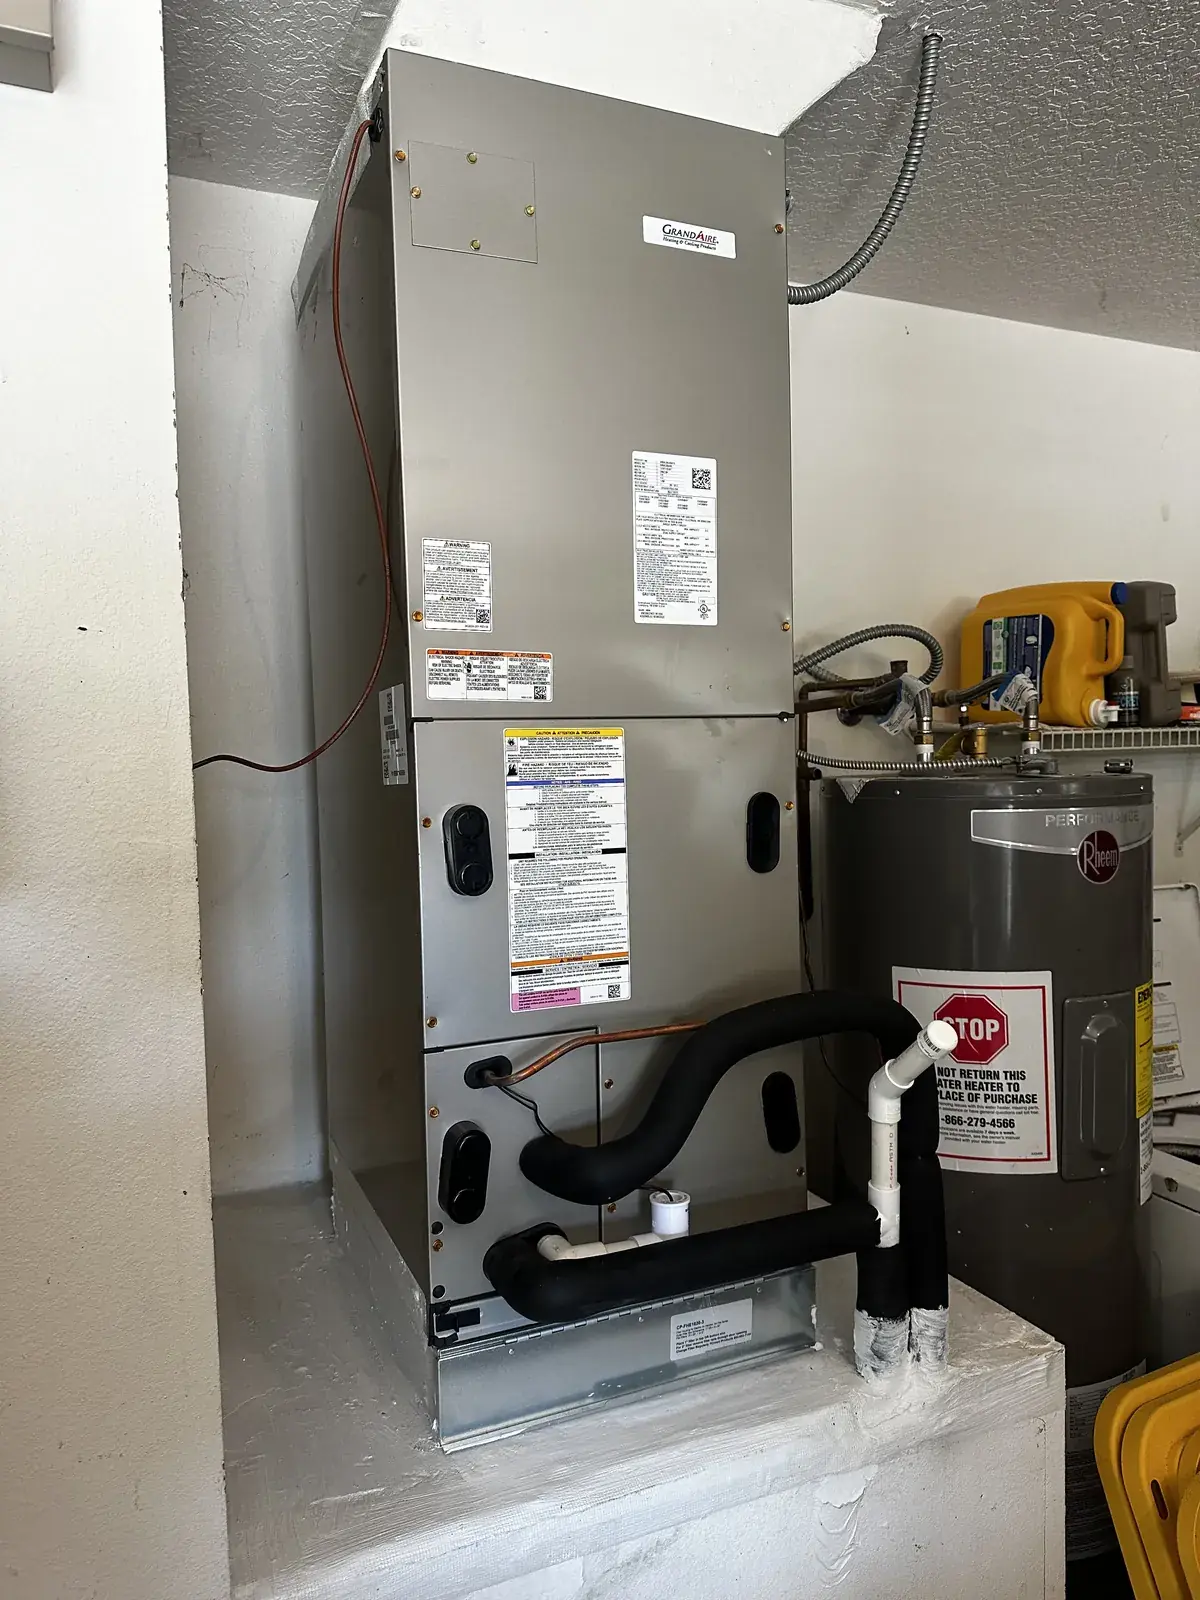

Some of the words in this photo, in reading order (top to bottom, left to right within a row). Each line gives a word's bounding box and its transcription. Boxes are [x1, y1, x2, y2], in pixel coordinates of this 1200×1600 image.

[1045, 810, 1139, 828] PERFORMANCE
[1084, 832, 1119, 875] Rheem
[937, 1066, 956, 1078] NOT
[960, 1068, 1000, 1080] RETURN
[1003, 1070, 1026, 1081] THIS
[937, 1078, 961, 1090] ATER
[964, 1080, 1003, 1092] HEATER
[1006, 1082, 1020, 1092] TO
[937, 1090, 964, 1102] LACE
[967, 1092, 981, 1103] OF
[984, 1093, 1038, 1104] PURCHASE
[941, 1115, 1015, 1129] -866-279-4566
